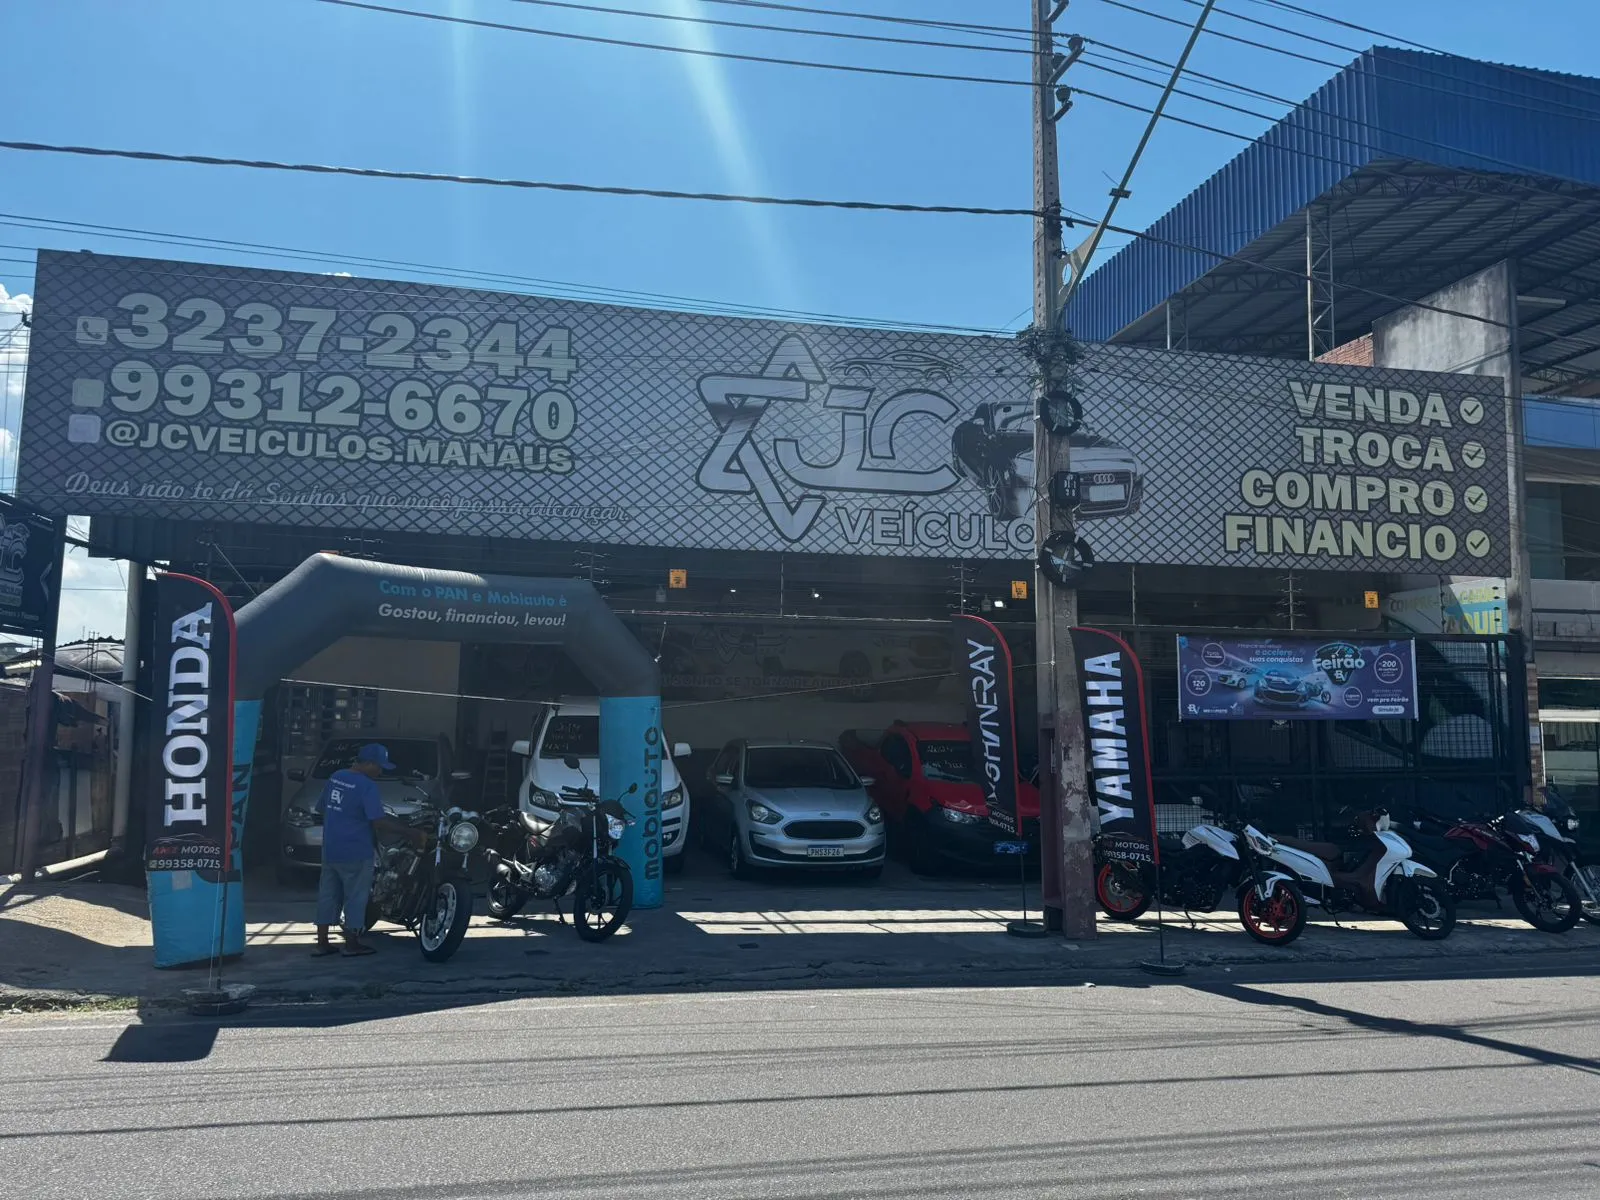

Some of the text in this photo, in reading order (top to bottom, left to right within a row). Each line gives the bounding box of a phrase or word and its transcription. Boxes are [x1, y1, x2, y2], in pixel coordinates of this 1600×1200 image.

[113, 291, 578, 384] 3237-2344
[108, 360, 577, 442] 99312-6670
[1288, 381, 1452, 428] VENDA
[106, 419, 573, 474] @JCVEICULOS.MANAUS
[774, 386, 961, 495] JC
[1295, 427, 1454, 472] TROCA
[65, 472, 129, 496] Deus
[137, 480, 185, 499] não
[191, 481, 214, 500] te
[221, 480, 252, 502] dá
[356, 494, 397, 513] que
[1241, 469, 1455, 516] COMPRO
[836, 501, 1036, 552] VEÍCULO
[1224, 514, 1457, 561] FINANCIO
[378, 603, 567, 628] Gostou, financiou, levou!
[379, 580, 417, 597] Com
[421, 588, 432, 598] o
[435, 586, 469, 601] PAN
[472, 592, 482, 602] e
[488, 590, 555, 607] Mobiauto
[1266, 656, 1304, 664] conquistas
[1312, 654, 1366, 671] Feirão
[1381, 660, 1397, 668] 200
[163, 601, 213, 826] HONDA
[966, 638, 1001, 779] SHINERAY
[1084, 651, 1135, 825] YAMAHA
[157, 857, 221, 869] 99358-0715
[181, 845, 221, 856] MOTORS
[1114, 841, 1150, 851] MOTORS
